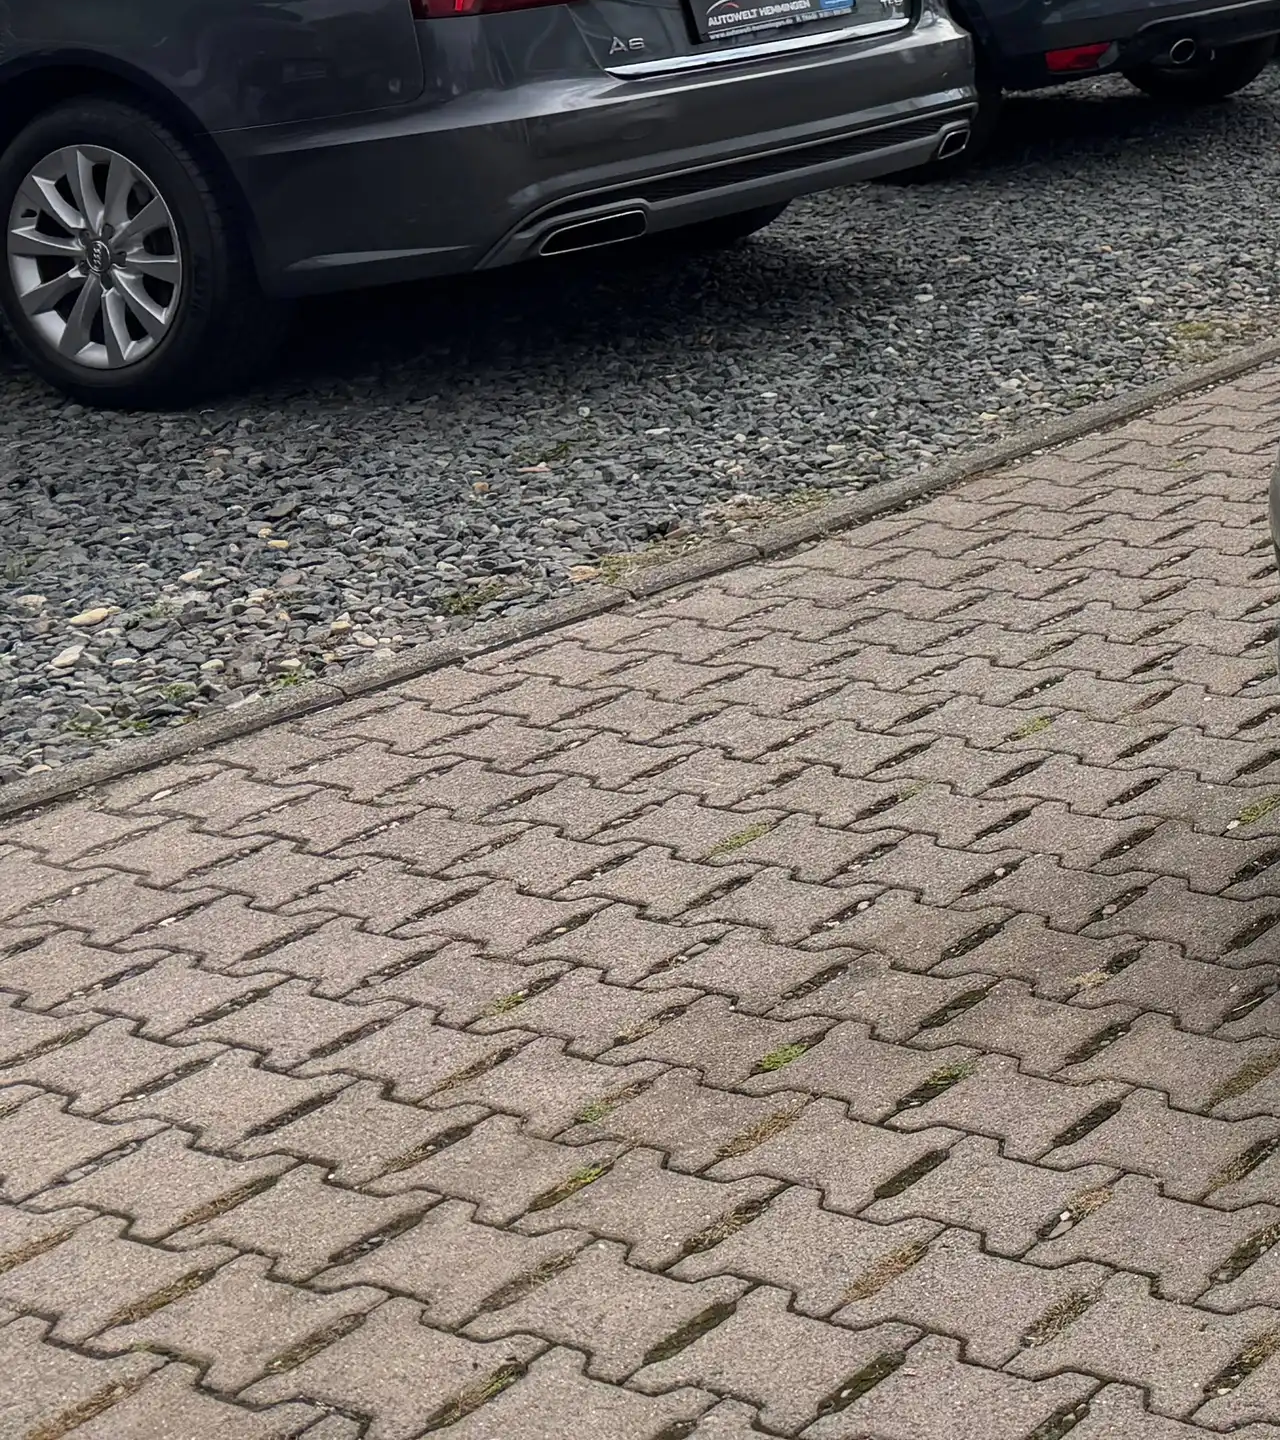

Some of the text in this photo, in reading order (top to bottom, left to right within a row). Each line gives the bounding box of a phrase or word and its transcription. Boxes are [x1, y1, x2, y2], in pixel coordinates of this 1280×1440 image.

[708, 8, 758, 27] AUTOWELT
[760, 0, 811, 17] HEMMINGEN
[608, 36, 645, 55] A6
